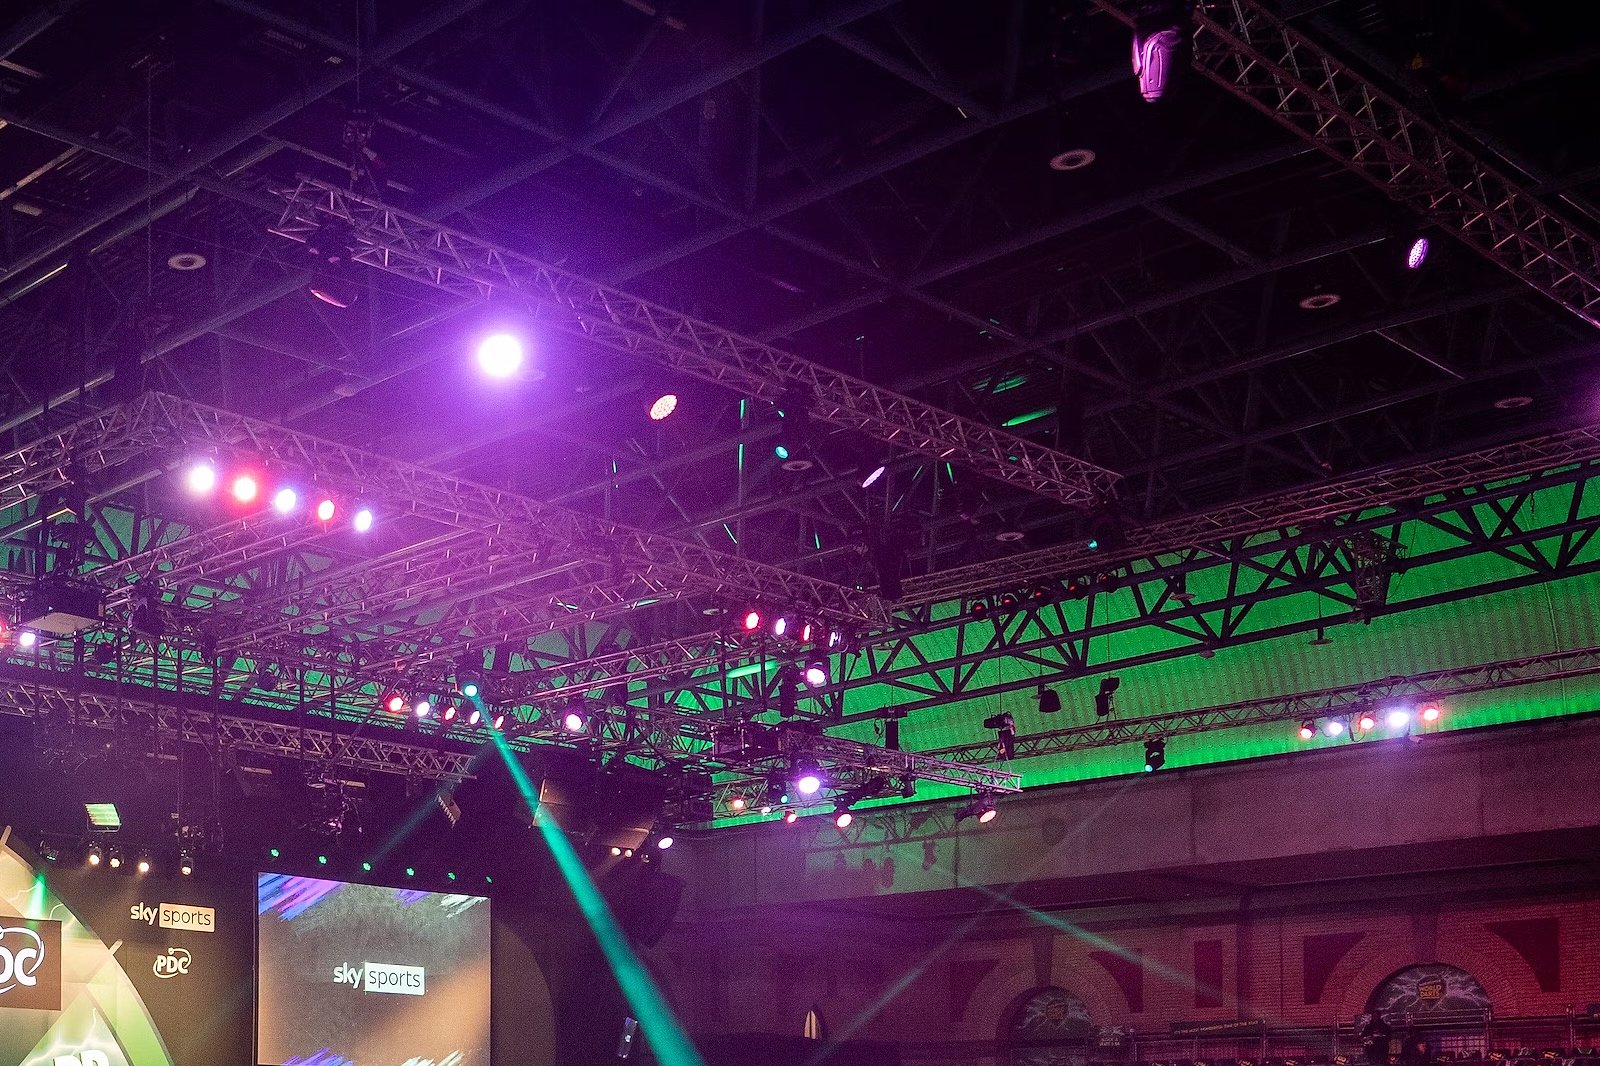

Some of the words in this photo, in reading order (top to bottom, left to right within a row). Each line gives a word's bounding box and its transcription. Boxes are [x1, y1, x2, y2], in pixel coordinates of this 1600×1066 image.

[130, 902, 158, 926] sky
[163, 909, 211, 926] sports
[157, 955, 189, 974] PDC
[333, 961, 363, 989] sky
[369, 970, 421, 989] sports
